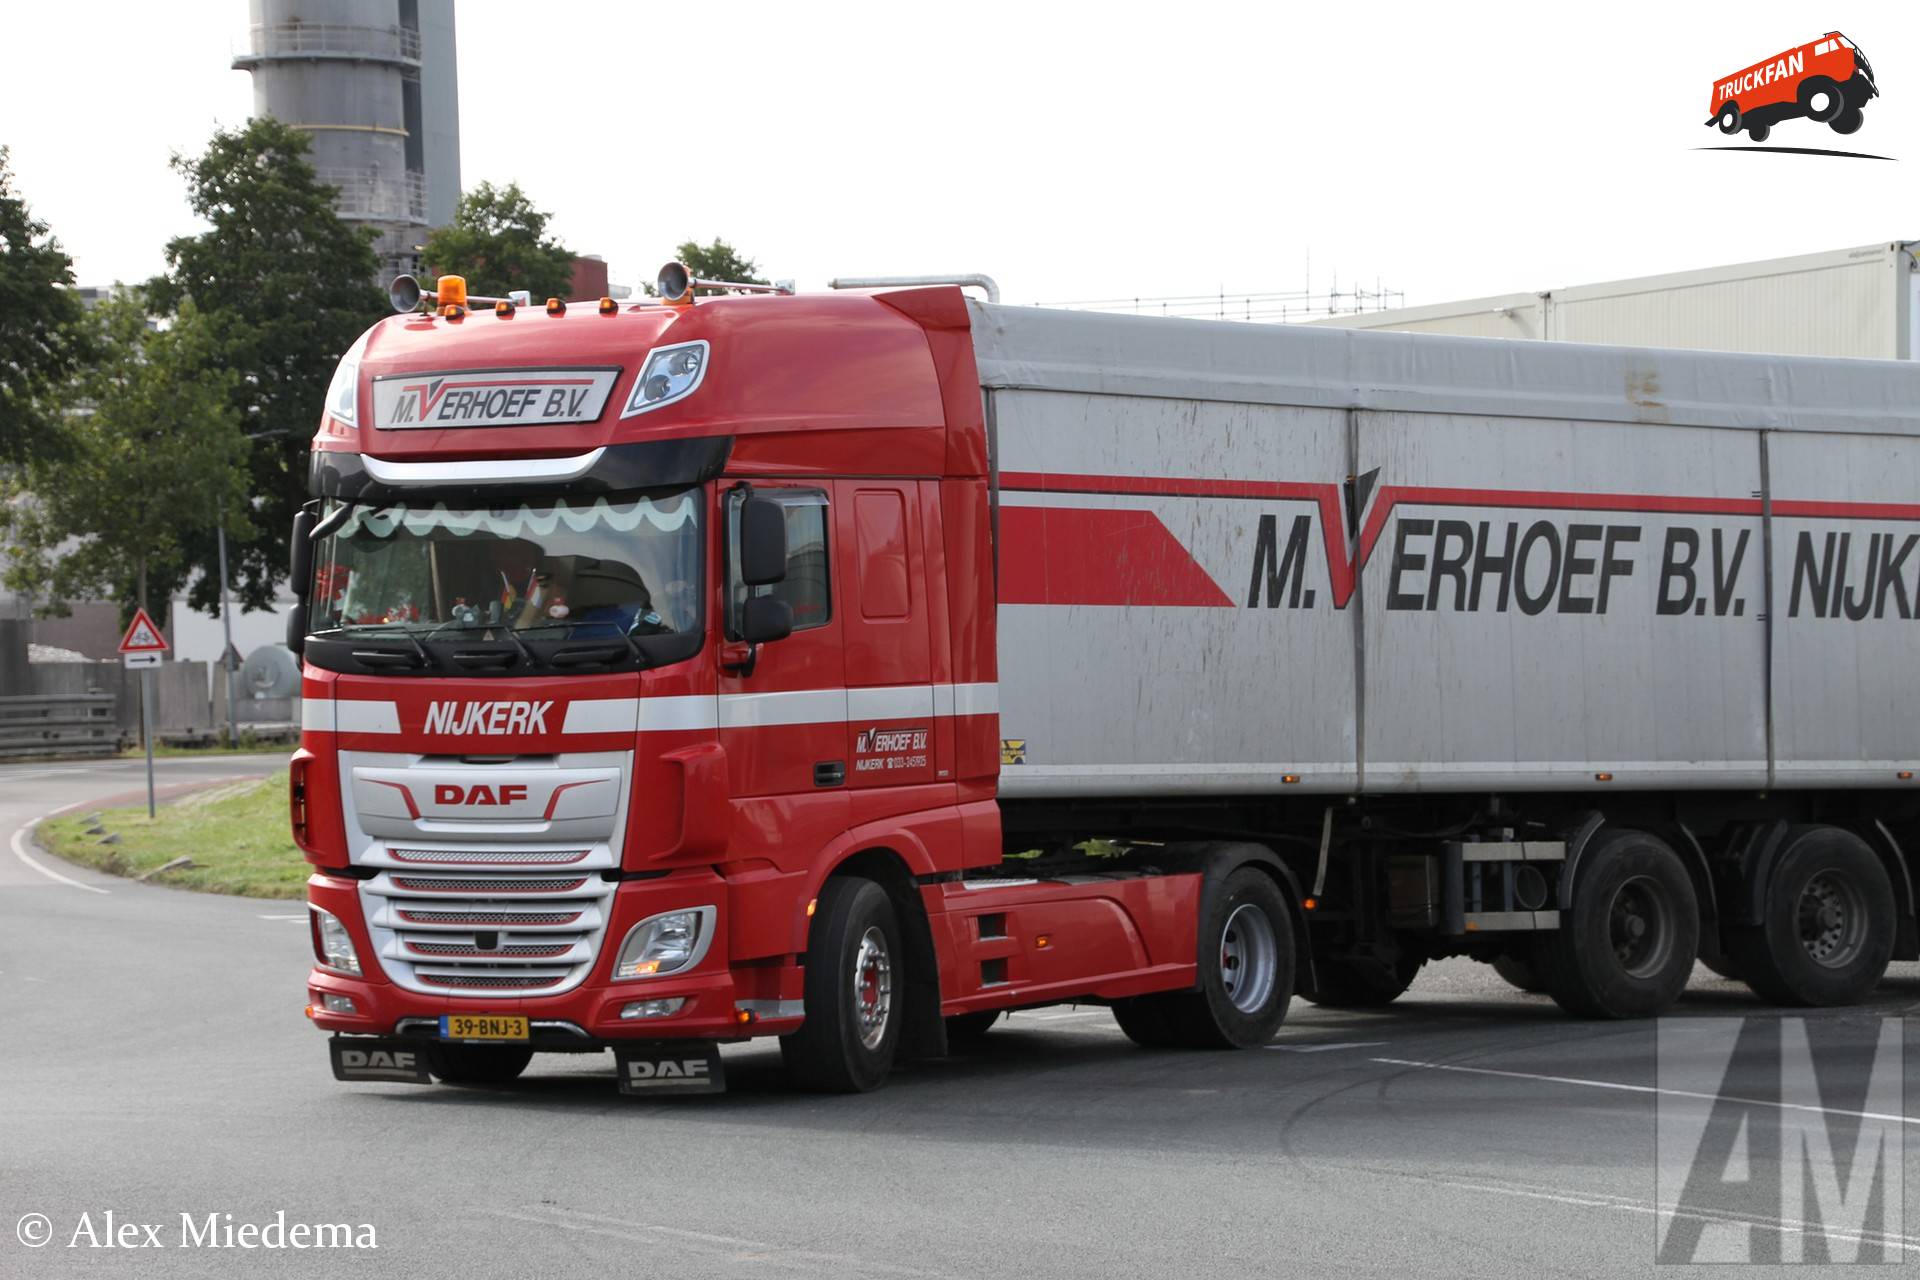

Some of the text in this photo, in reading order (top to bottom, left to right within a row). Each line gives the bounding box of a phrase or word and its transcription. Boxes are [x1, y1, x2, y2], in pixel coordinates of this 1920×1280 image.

[543, 389, 588, 418] B.V.
[1656, 526, 1751, 617] B.V.
[1788, 531, 1920, 621] NIJK
[423, 701, 554, 736] NIJKERK
[912, 733, 927, 750] B.V.
[434, 785, 527, 805] DAF
[454, 1018, 522, 1035] 39-BNJ-3
[341, 1050, 416, 1068] DAF
[628, 1060, 709, 1078] DAF
